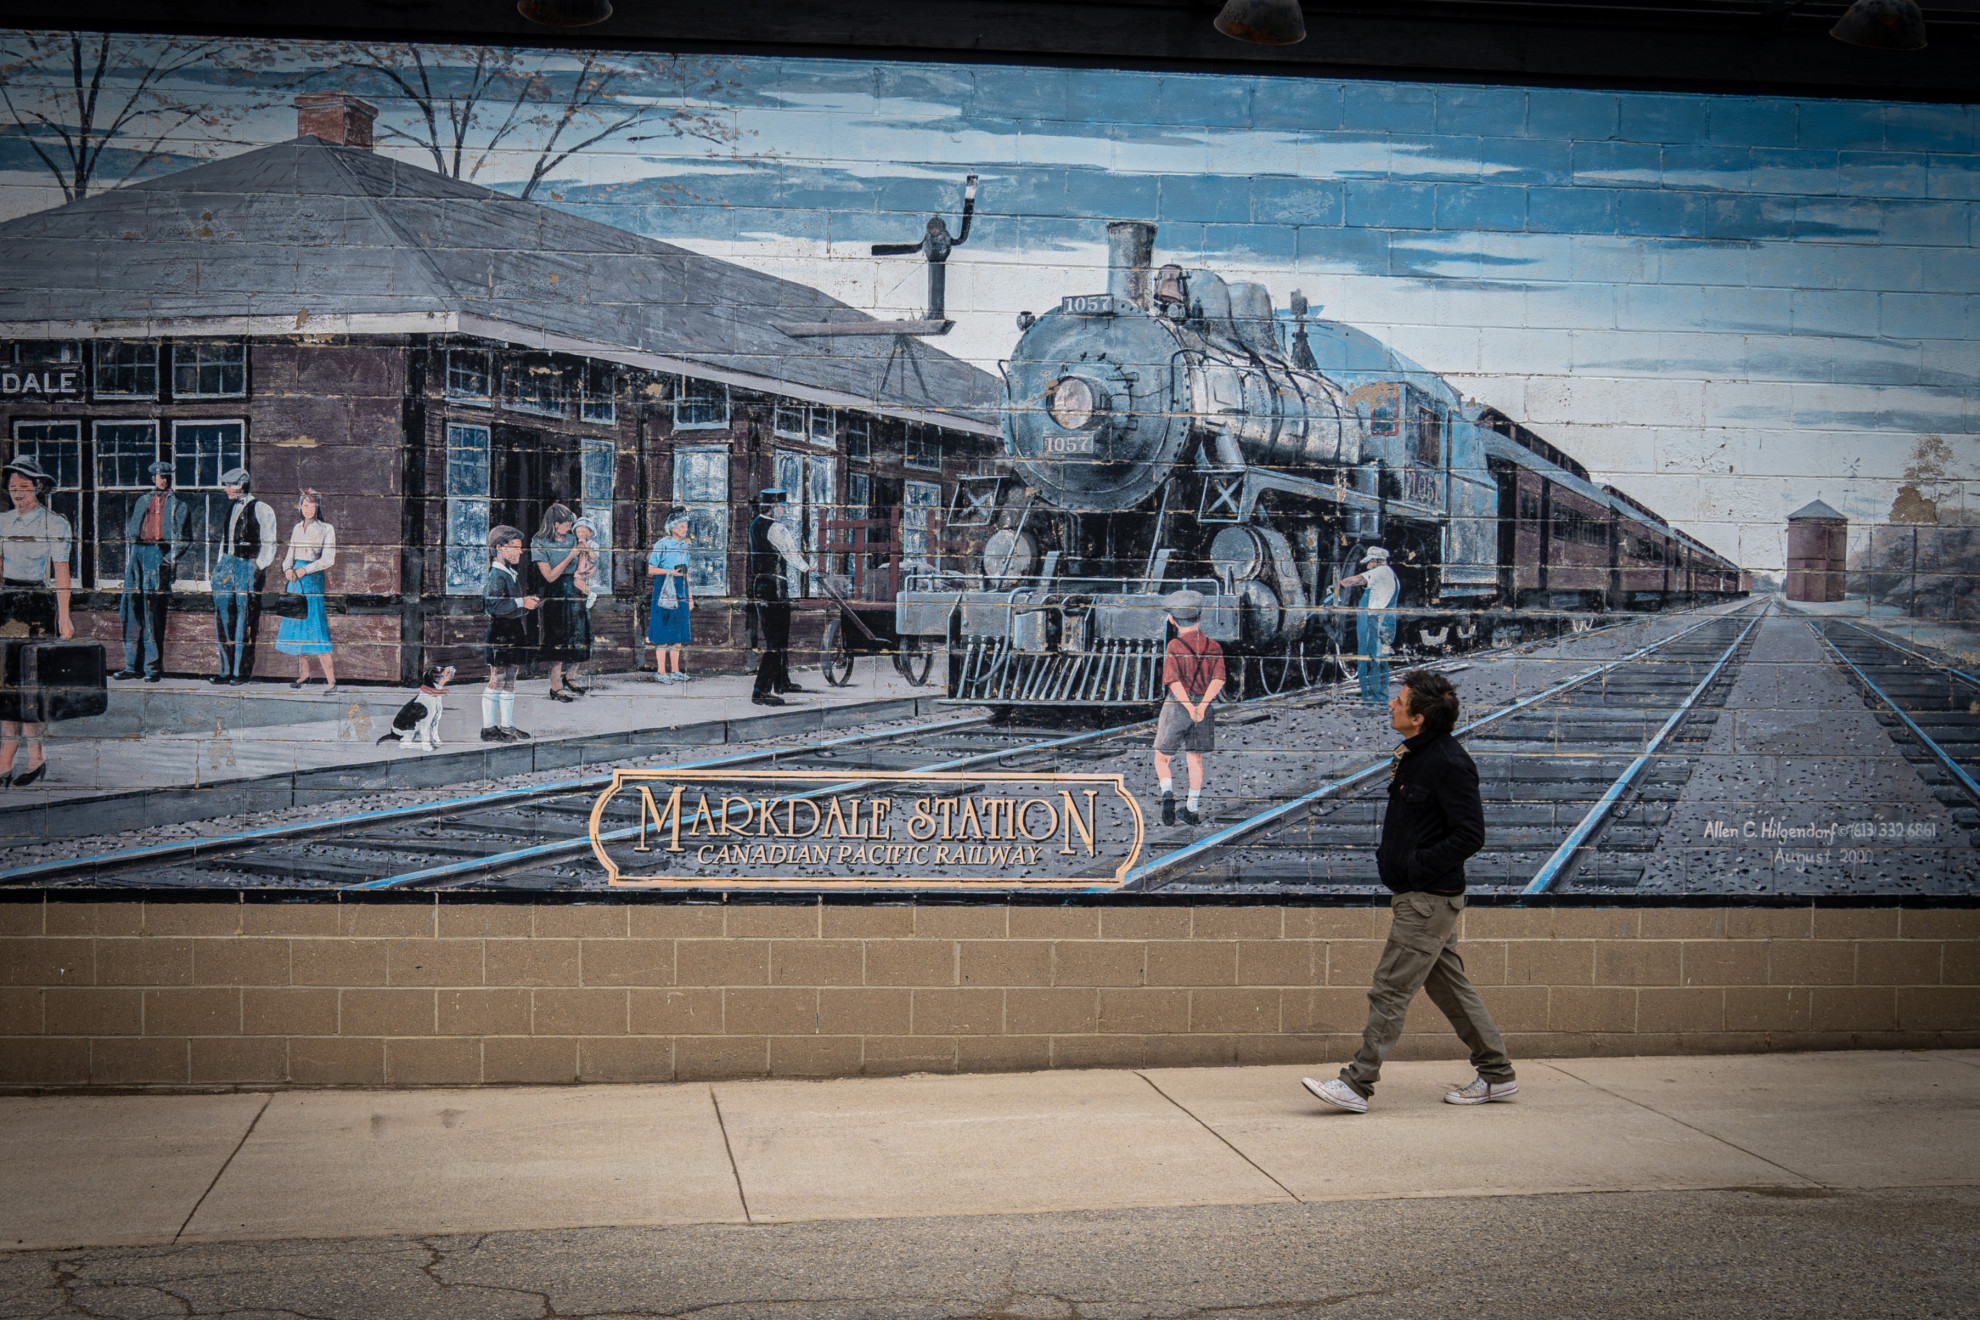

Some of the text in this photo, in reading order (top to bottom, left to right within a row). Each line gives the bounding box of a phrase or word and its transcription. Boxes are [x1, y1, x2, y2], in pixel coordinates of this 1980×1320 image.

[1065, 295, 1111, 313] 1057
[2, 372, 76, 394] DALE
[1045, 437, 1090, 453] 1057
[634, 785, 1098, 857] MARKDALE STATION
[1703, 820, 1739, 840] Allen
[1743, 820, 1758, 839] C.
[1761, 816, 1838, 846] Hilgendorf
[1878, 822, 1904, 837] 332
[1907, 822, 1937, 837] 6861
[697, 844, 1043, 866] CANADIAN PACIFIC RAILWAY
[1774, 847, 1832, 873] August
